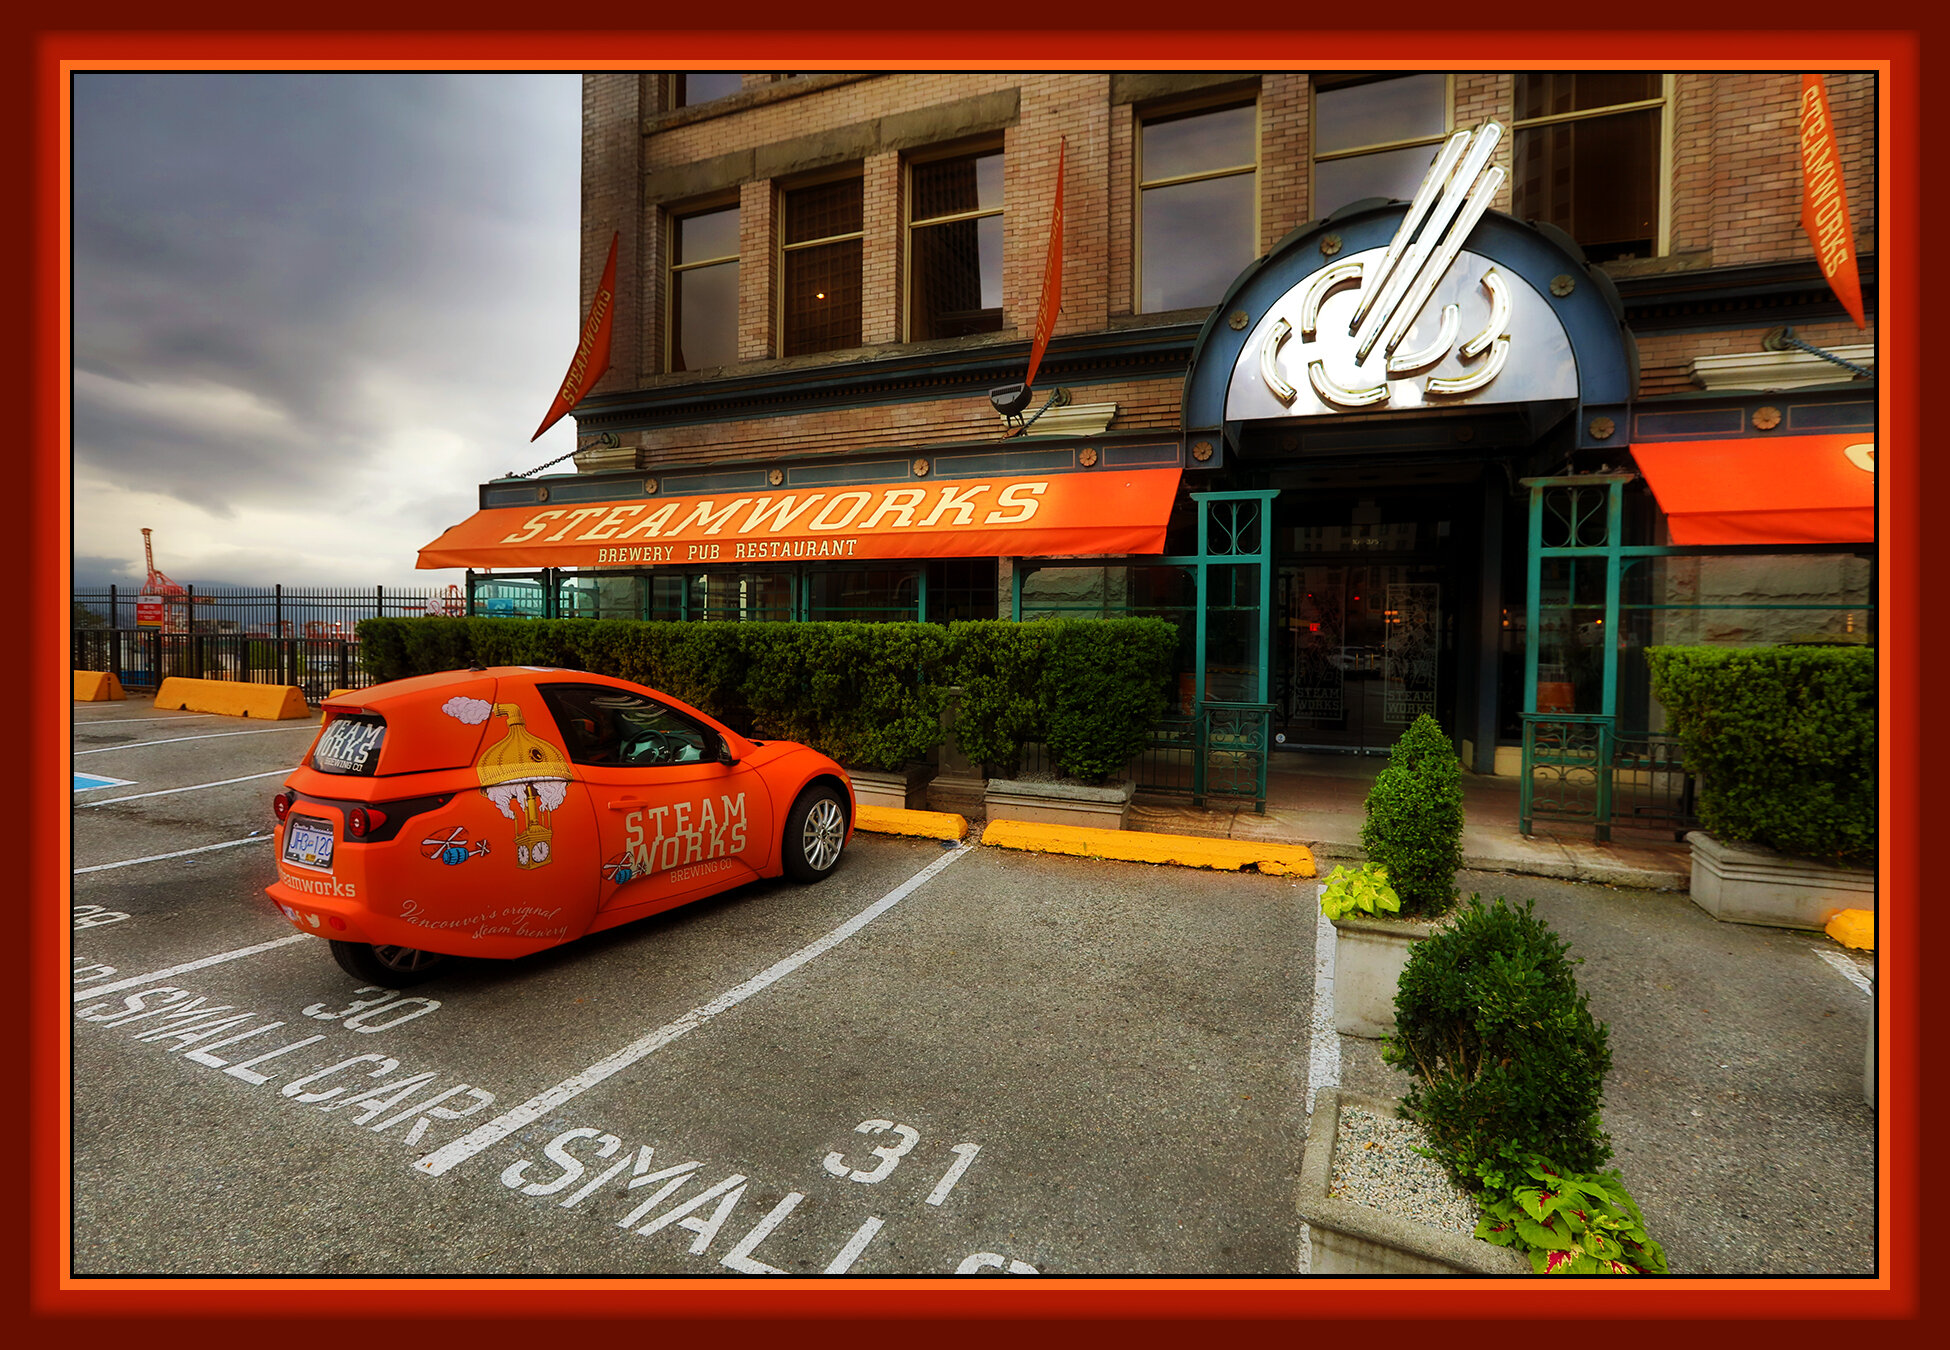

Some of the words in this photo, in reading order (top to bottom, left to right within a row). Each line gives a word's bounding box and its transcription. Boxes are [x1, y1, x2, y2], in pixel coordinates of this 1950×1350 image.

[501, 482, 1048, 544] STEAMWORKS
[597, 545, 674, 563] BREWERY
[687, 543, 721, 561] PUB
[735, 539, 857, 560] RESTAURANT
[1296, 687, 1340, 698] STEAM
[1296, 700, 1340, 710] WORKS
[1387, 690, 1433, 701] STEAM
[1387, 702, 1433, 713] WORKS
[625, 792, 747, 847] STEAM
[627, 822, 747, 879] WORKS
[670, 861, 718, 883] BREWING
[400, 900, 497, 929] Vancouver's
[502, 901, 562, 925] original
[472, 923, 511, 939] steam
[516, 922, 568, 944] brewery
[302, 985, 442, 1034] 30
[76, 986, 327, 1086] SMALL
[281, 1053, 497, 1148] CAR
[822, 1118, 984, 1207] 31
